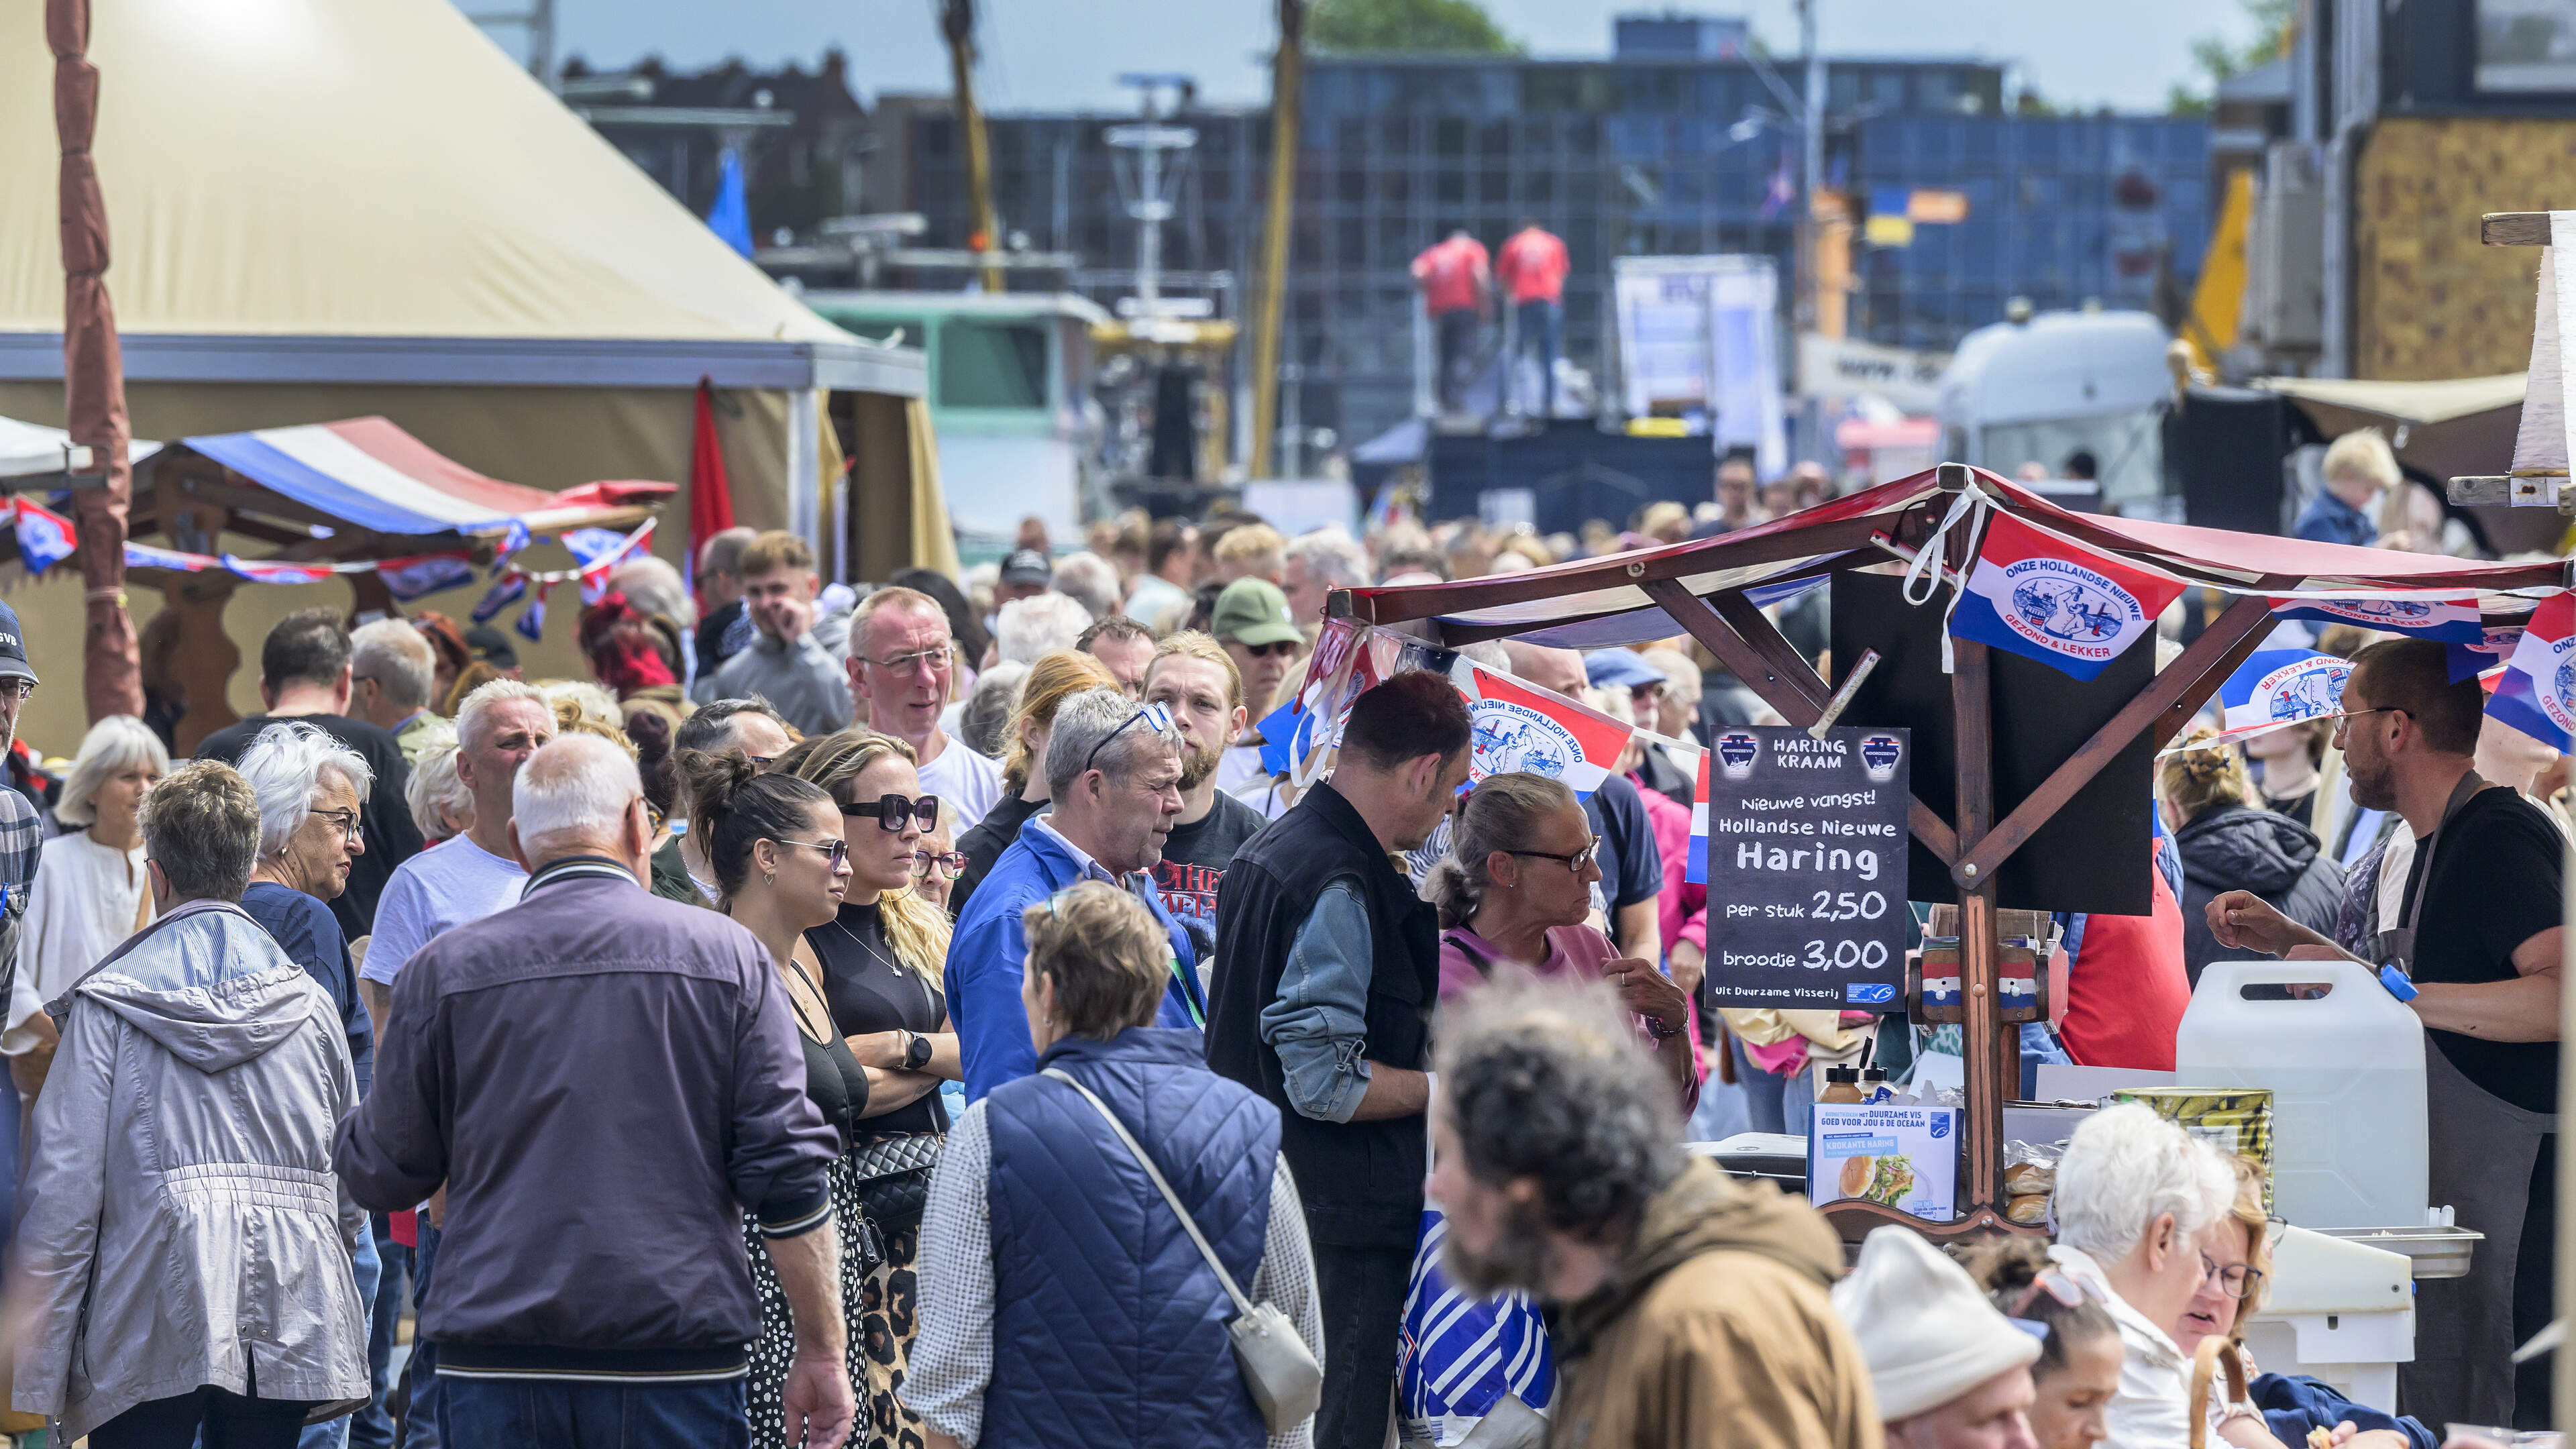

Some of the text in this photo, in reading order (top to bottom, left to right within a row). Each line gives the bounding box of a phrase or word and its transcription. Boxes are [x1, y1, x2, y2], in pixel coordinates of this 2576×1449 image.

[2006, 560, 2141, 621] ONZE HOLLANDSE NIEUWE
[2320, 605, 2370, 620] GEZOND
[2385, 617, 2432, 626] LEKKER
[2005, 614, 2110, 657] GEZOND & LEKKER
[2553, 637, 2576, 653] ONZ
[2261, 665, 2302, 690] LEKKER
[1774, 739, 1847, 755] HARING
[1777, 755, 1841, 769] KRAAM
[1741, 790, 1876, 810] Nieuwe vangst!
[1719, 818, 1896, 837] Hollandse Nieuwe
[1737, 841, 1878, 881] Haring
[1726, 890, 1886, 922] per stuk 2,50
[1723, 940, 1888, 971] broodje 3,00
[1735, 987, 1790, 998] Duurzame
[1794, 988, 1839, 1000] Visserij
[1826, 1139, 1894, 1150] KROKANTE HARING
